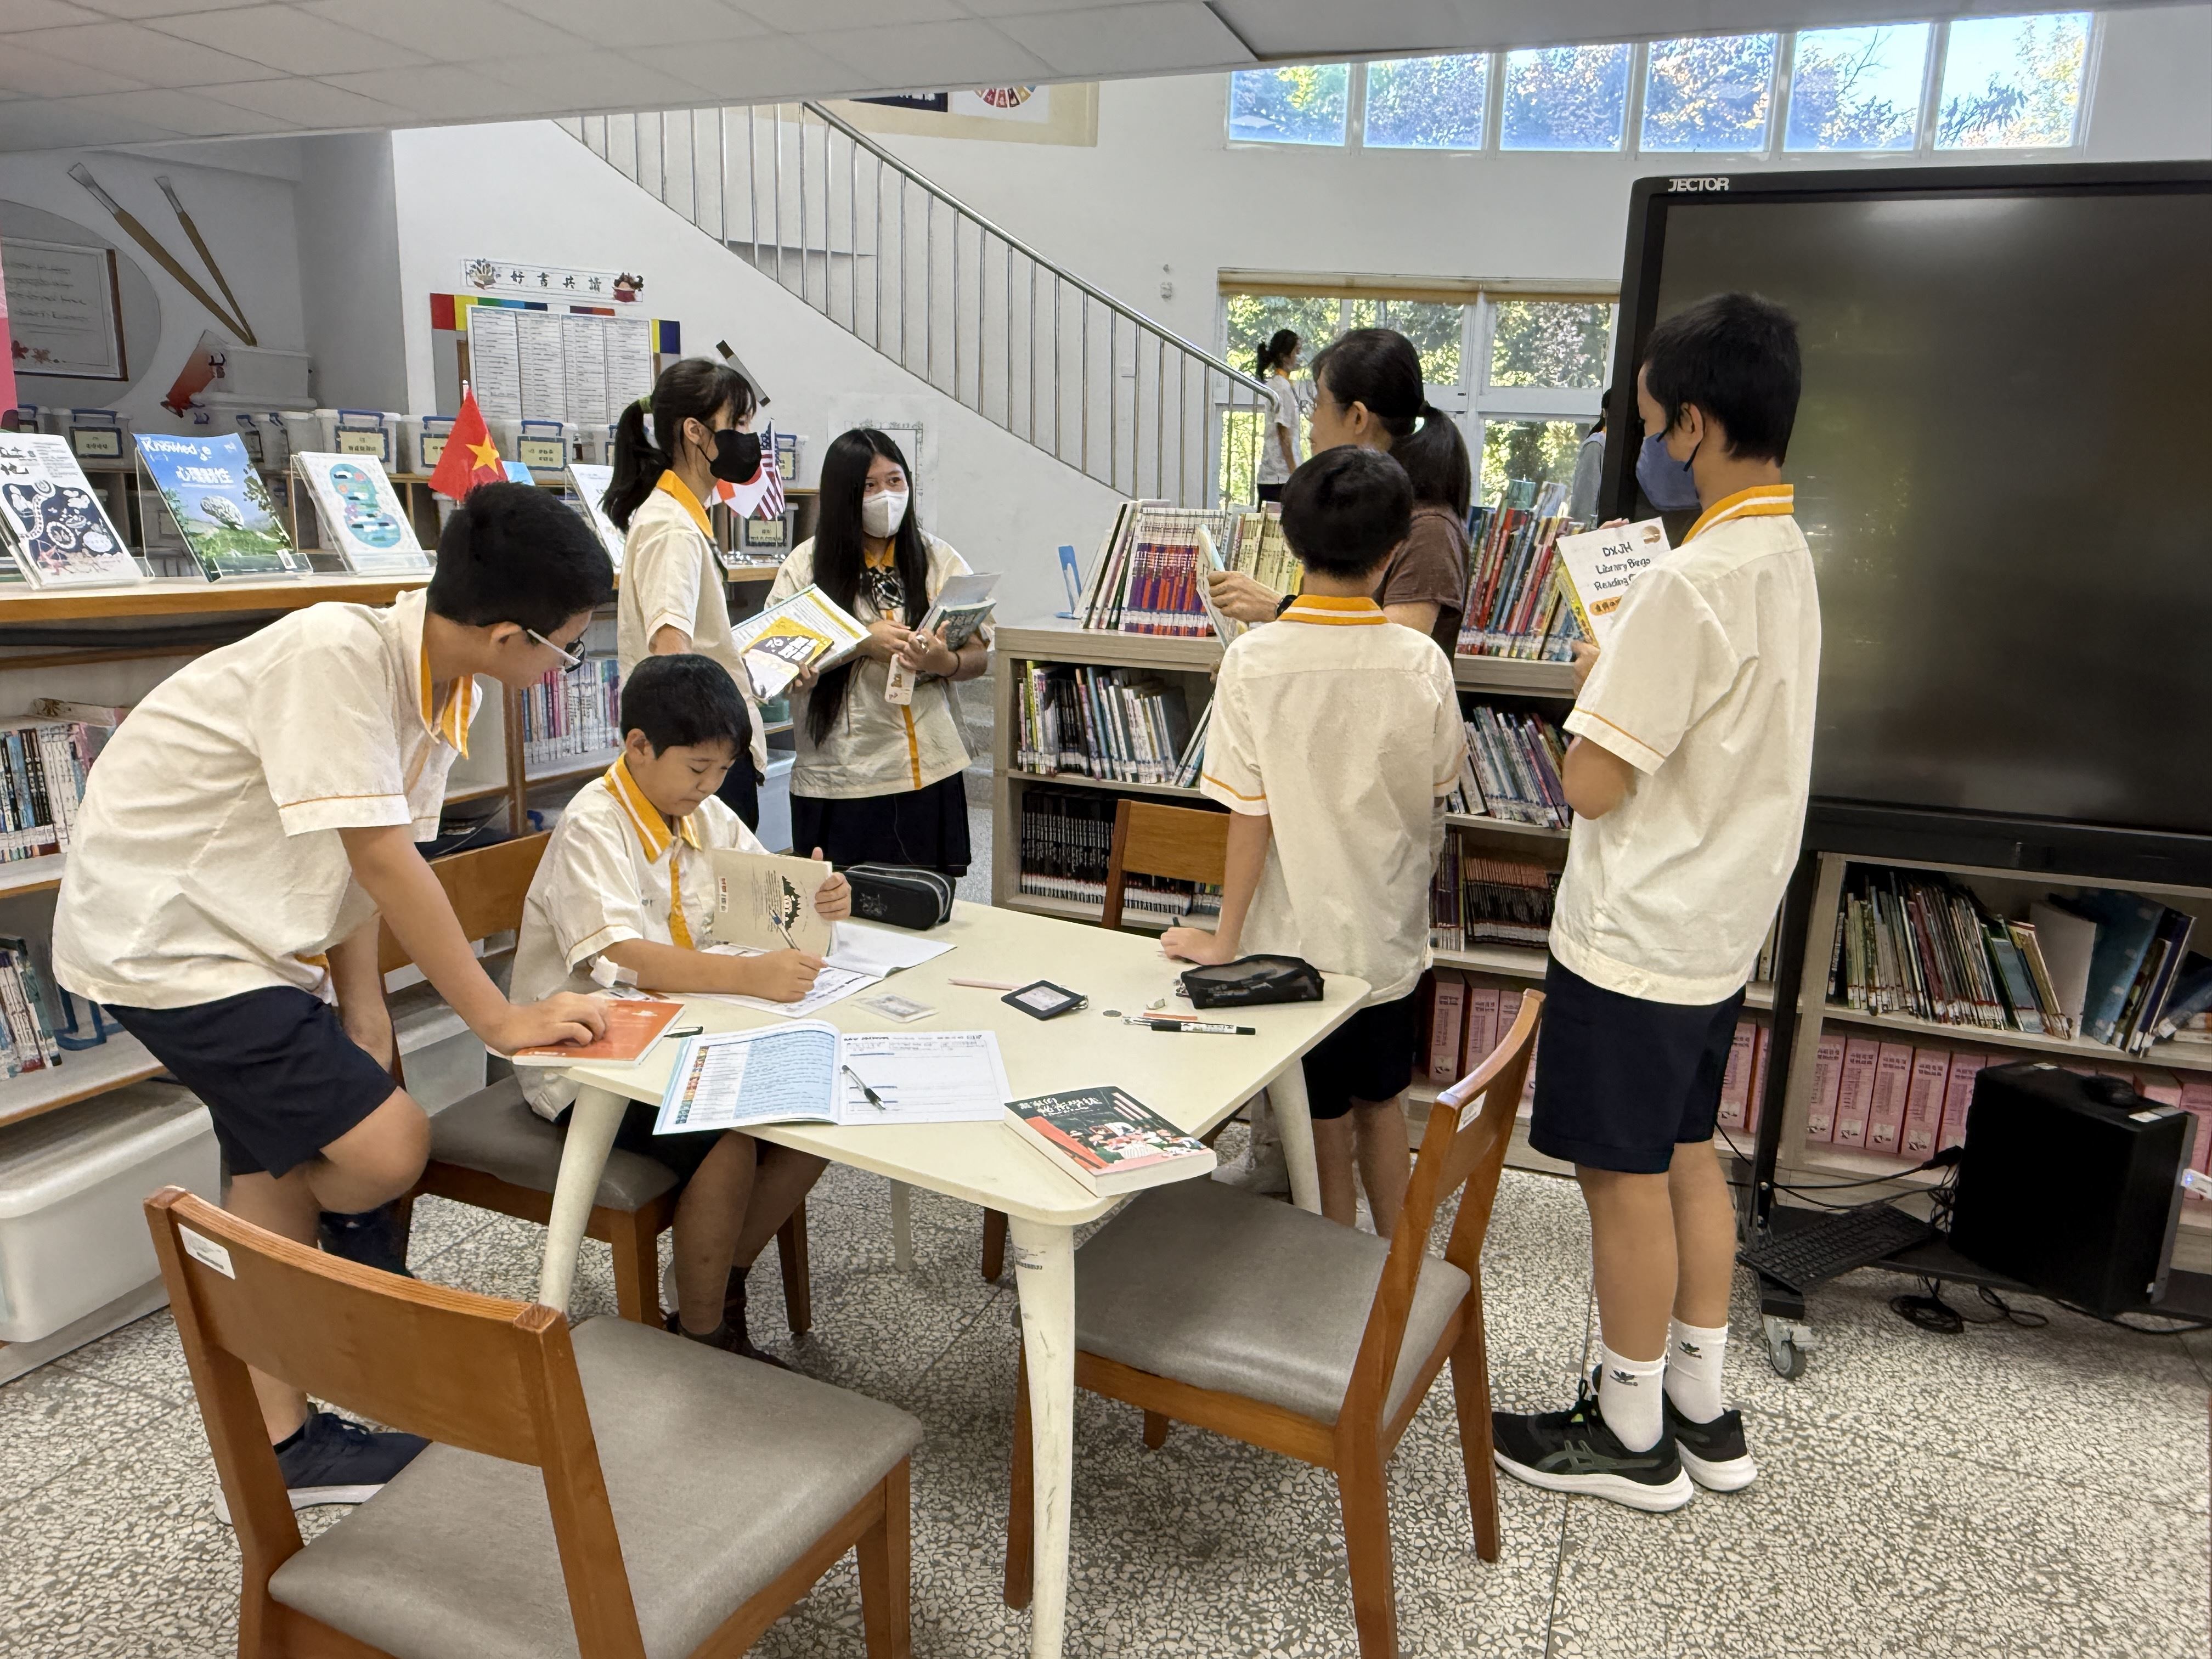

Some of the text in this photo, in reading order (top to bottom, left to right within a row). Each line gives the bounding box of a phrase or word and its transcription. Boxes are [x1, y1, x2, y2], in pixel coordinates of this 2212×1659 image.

[1668, 177, 1729, 192] JECTOR
[1602, 541, 1633, 557] DXJH
[1595, 558, 1651, 574] Library Bingo
[1593, 578, 1629, 591] Reading
